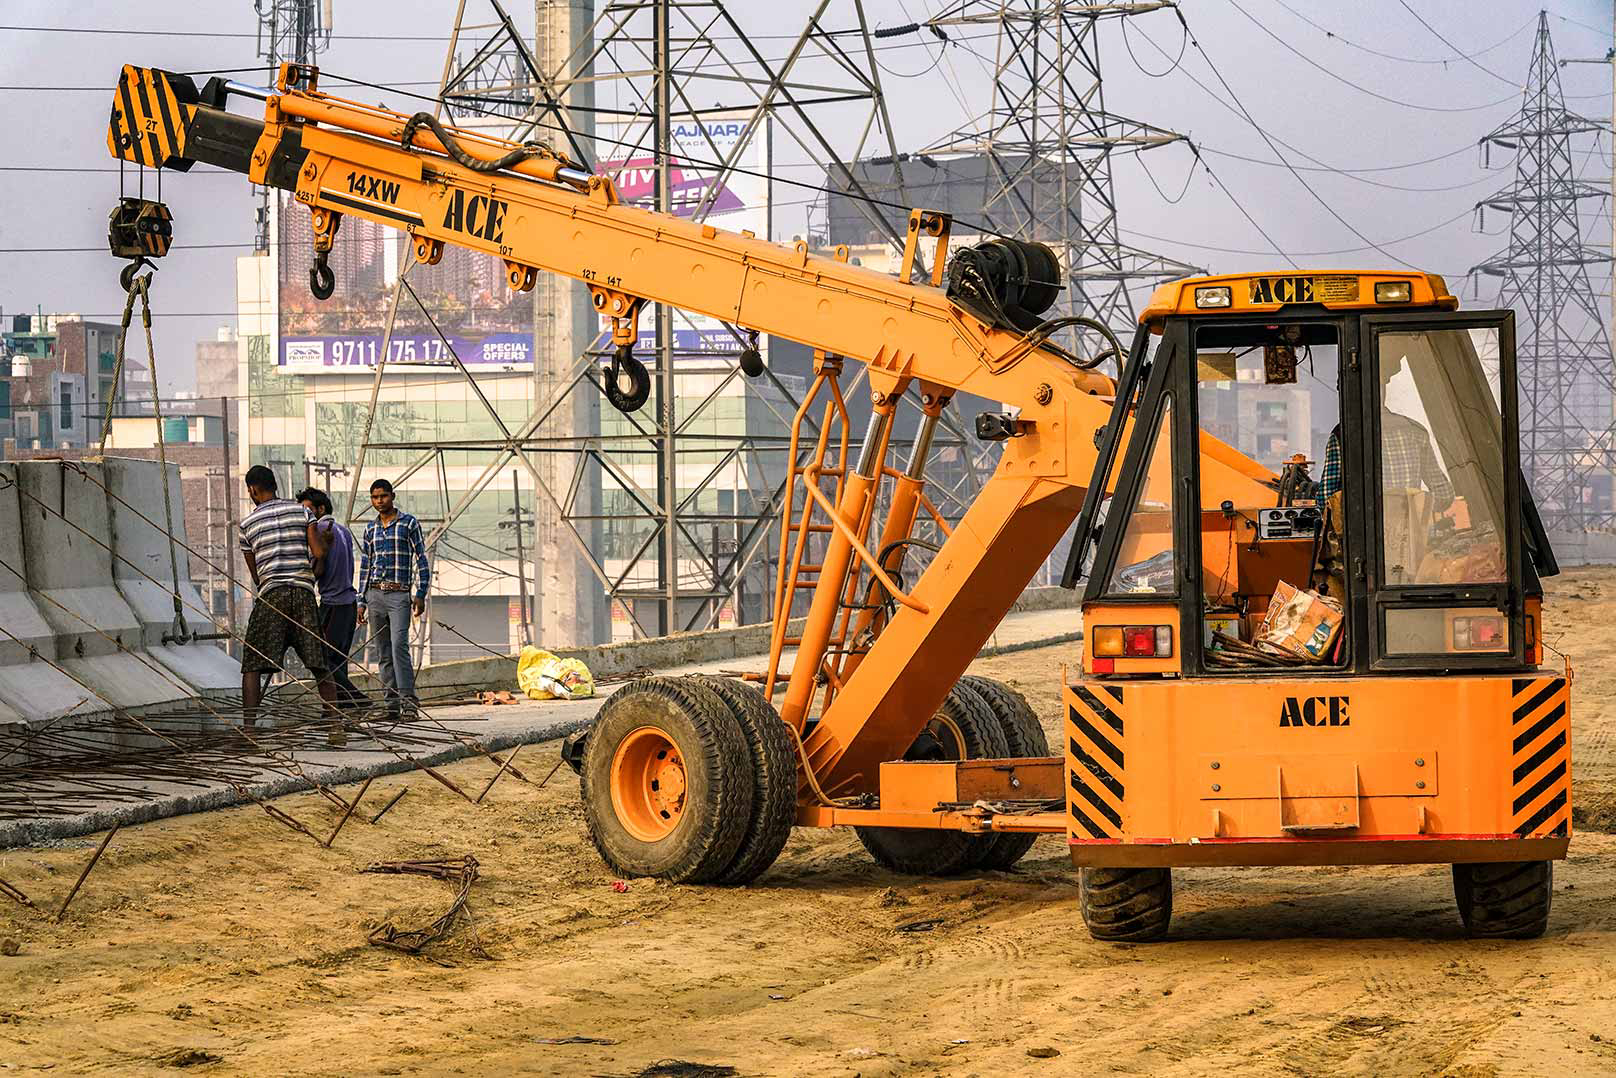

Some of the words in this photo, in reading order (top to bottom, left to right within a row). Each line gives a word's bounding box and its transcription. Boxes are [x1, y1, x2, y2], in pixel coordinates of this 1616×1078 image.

[146, 120, 157, 131] 2T
[347, 172, 400, 204] 14XW
[407, 223, 416, 234] 6T
[443, 189, 508, 244] ACE
[1254, 277, 1314, 304] ACE
[332, 341, 376, 365] 9711
[483, 343, 529, 352] SPECIAL
[483, 352, 526, 361] OFFERS
[1279, 696, 1350, 727] ACE
